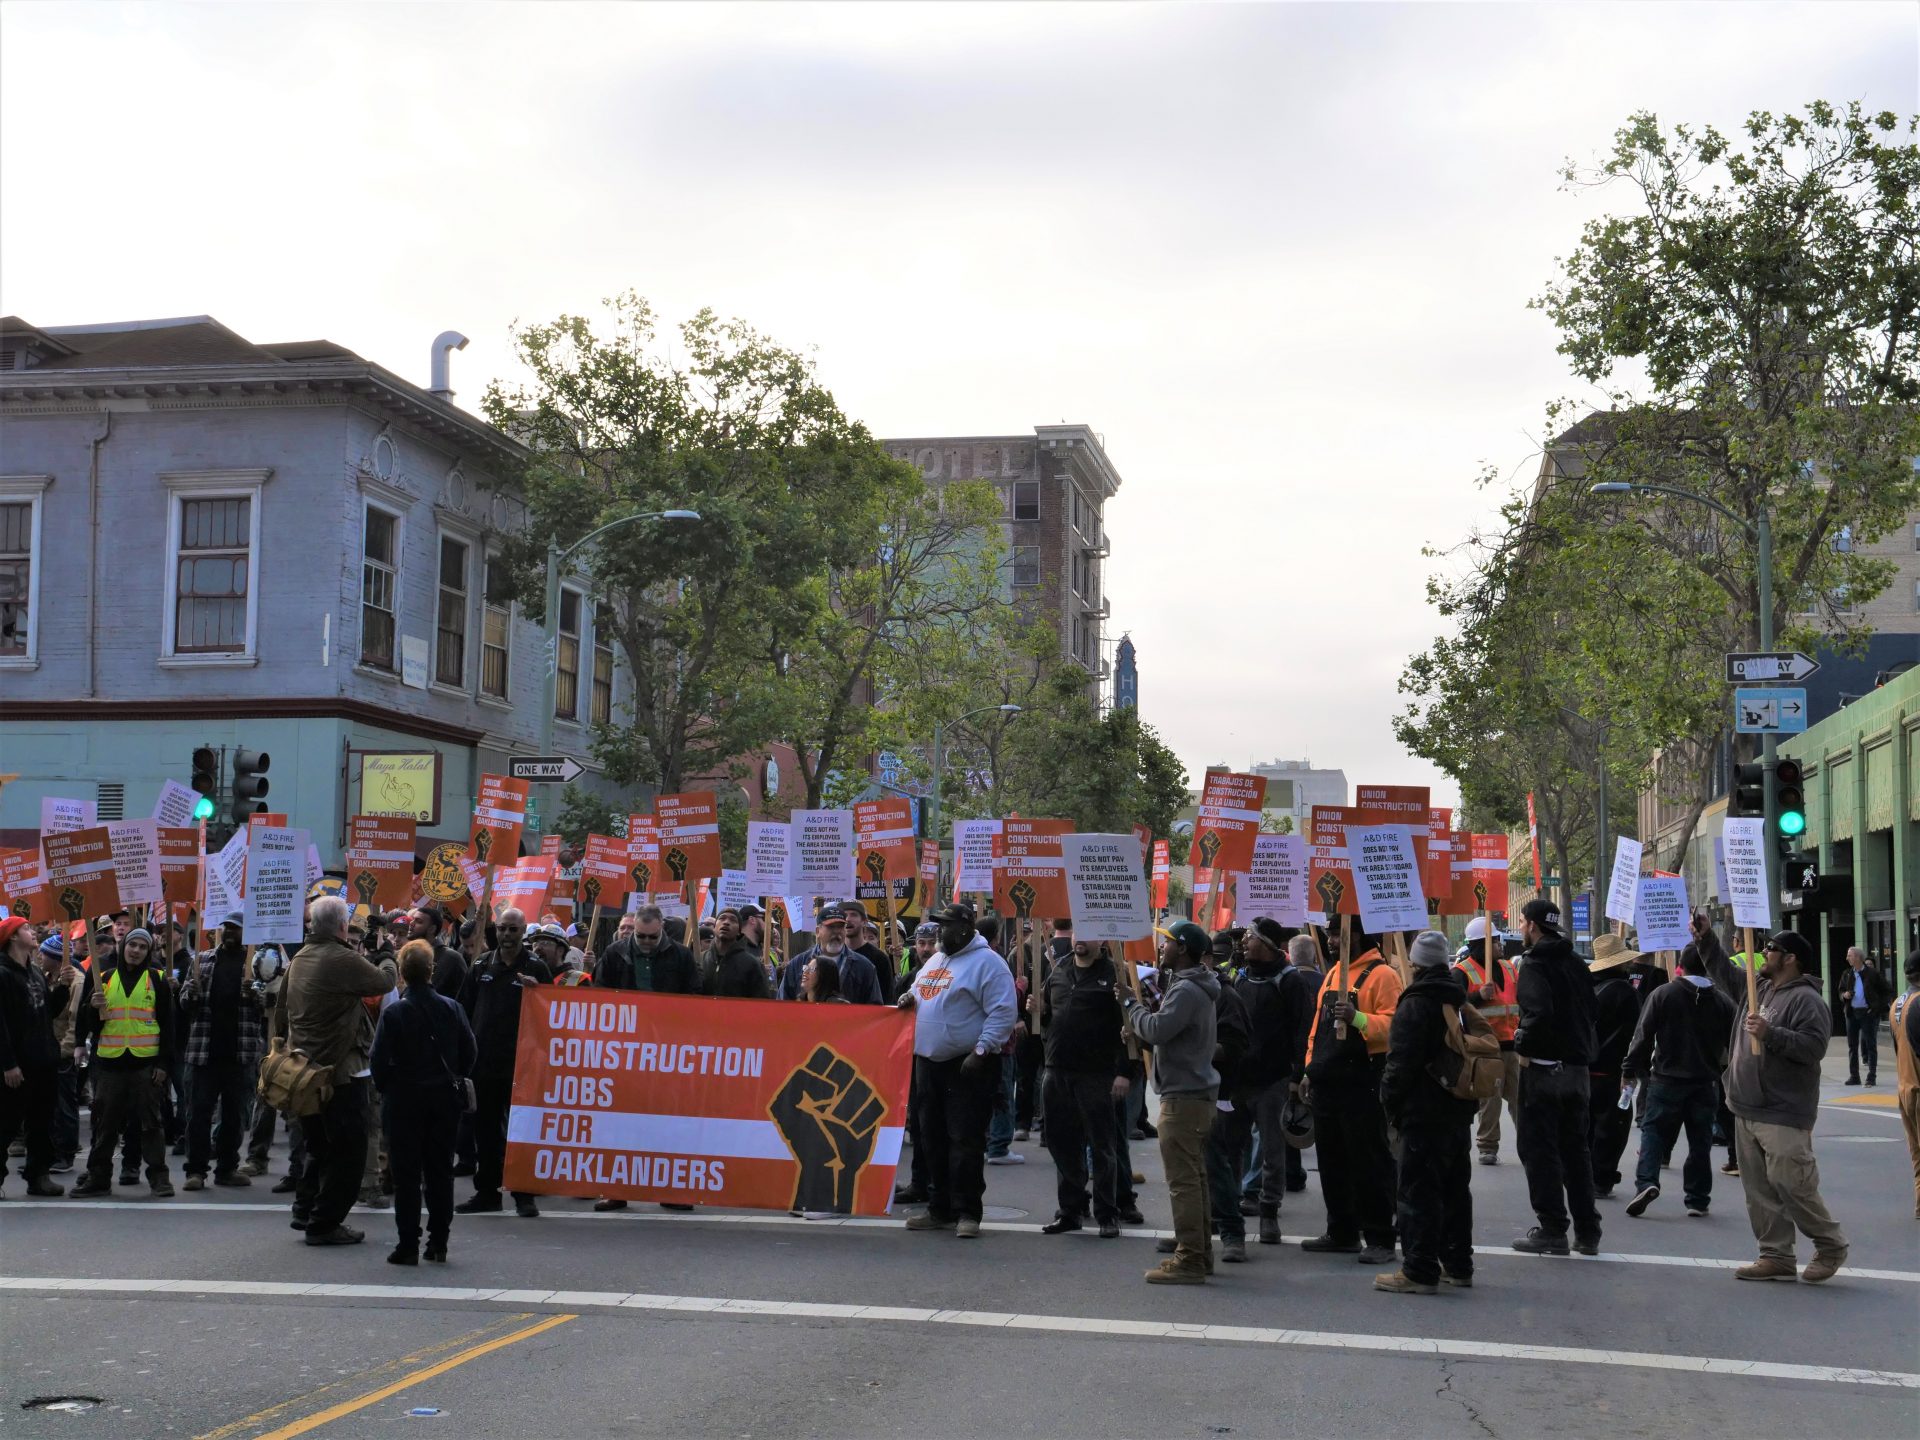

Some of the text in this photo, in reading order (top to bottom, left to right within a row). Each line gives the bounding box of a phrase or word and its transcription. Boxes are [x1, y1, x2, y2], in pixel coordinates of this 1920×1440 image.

[1778, 662, 1791, 671] AY
[365, 758, 433, 773] Maya Halal
[517, 765, 563, 775] ONE WAY
[484, 778, 500, 787] UNION
[1210, 776, 1254, 788] TRABAJOS DE
[482, 788, 522, 801] CONSTRUCTION
[1208, 786, 1258, 798] CONSTRUCCIÓN
[1362, 790, 1386, 798] UNION
[659, 799, 679, 807] UNION
[1224, 798, 1245, 808] UNIÓN
[1362, 802, 1422, 811] CONSTRUCTION
[660, 806, 710, 817] CONSTRUCTION
[858, 806, 877, 814] UNION
[1203, 808, 1219, 816] PARA
[860, 812, 905, 823] CONSTRUCTION
[1317, 811, 1342, 820] UNION
[356, 820, 378, 828] UNION
[476, 817, 513, 830] OAKLANDERS
[1201, 819, 1244, 830] OAKLANDERS
[356, 830, 408, 840] CONSTRUCTION
[1008, 836, 1060, 844] CONSTRUCTIO
[1316, 836, 1336, 844] JOBS
[1364, 834, 1382, 842] A&D
[47, 837, 70, 847] UNION
[662, 836, 706, 846] OAKLANDERS
[862, 839, 902, 849] OAKLANDERS
[50, 842, 103, 857] CONSTRUCTION
[1316, 848, 1330, 856] FOR
[52, 858, 70, 867] JOBS
[354, 860, 400, 869] OAKLANDERS
[1315, 859, 1352, 869] OAKLAND
[53, 868, 66, 877] FOR
[426, 870, 440, 879] ONE
[1007, 869, 1058, 877] OAKLANDERS
[54, 873, 101, 886] OAKLANDERS
[549, 1001, 637, 1033] UNION
[549, 1038, 764, 1078] CONSTRUCTION
[544, 1075, 614, 1107] JOBS
[540, 1112, 592, 1143] FOR
[534, 1150, 724, 1191] OAKLANDERS
